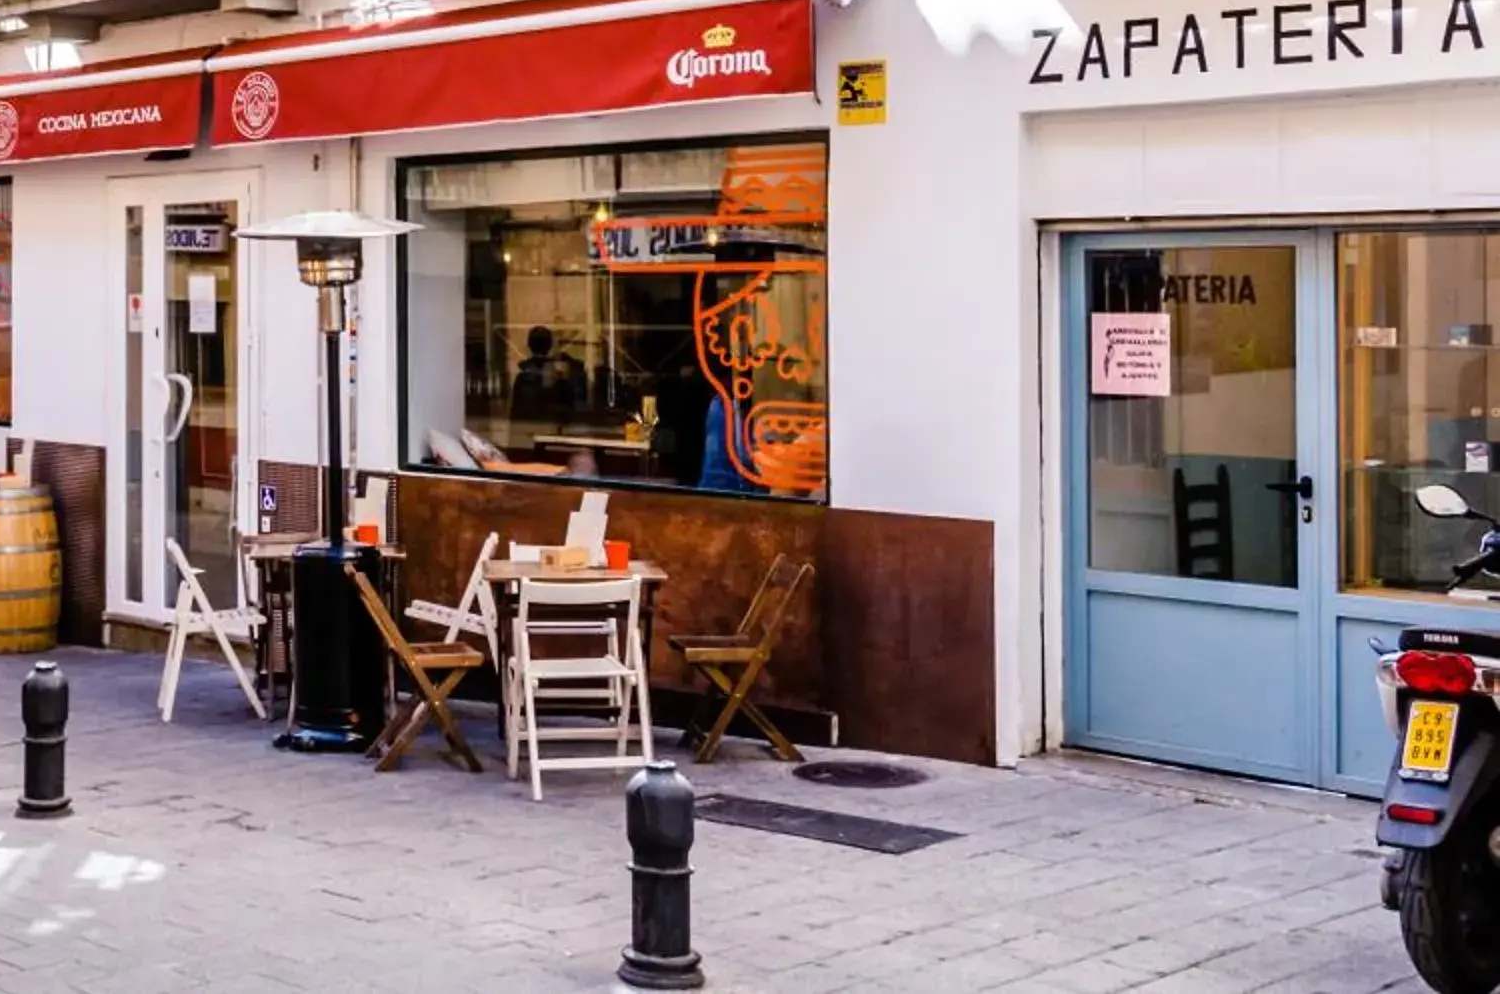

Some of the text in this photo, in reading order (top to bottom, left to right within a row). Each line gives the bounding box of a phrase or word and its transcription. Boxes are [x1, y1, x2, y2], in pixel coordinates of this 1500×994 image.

[666, 48, 772, 88] Corona
[37, 113, 87, 134] COCINA
[91, 105, 162, 127] MEXICANA
